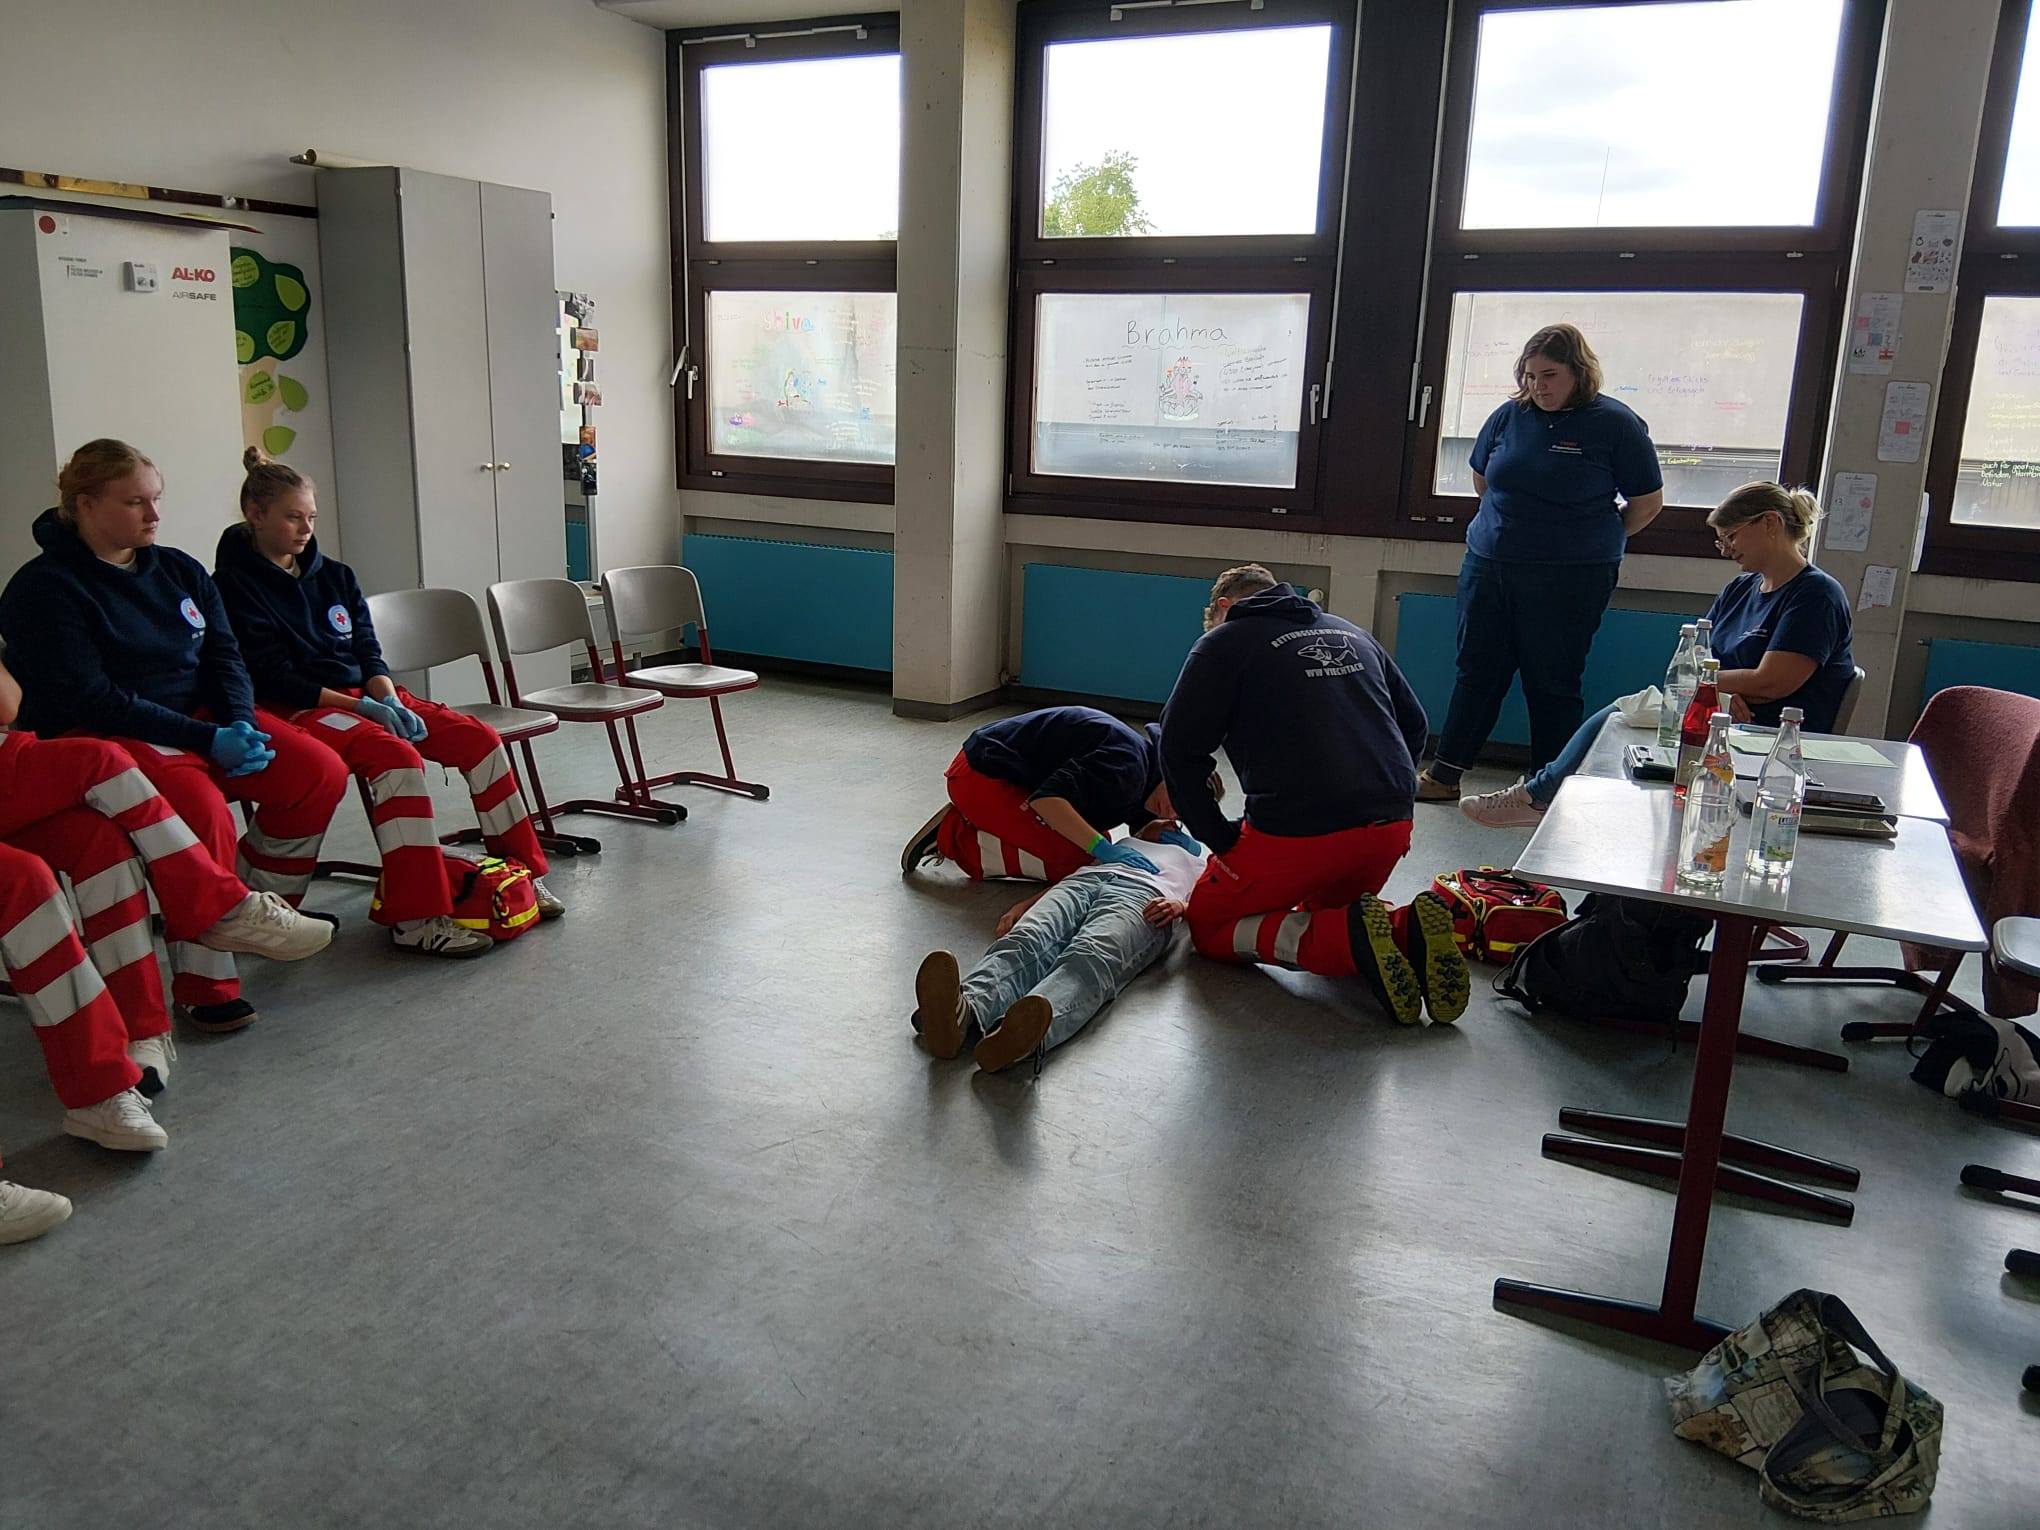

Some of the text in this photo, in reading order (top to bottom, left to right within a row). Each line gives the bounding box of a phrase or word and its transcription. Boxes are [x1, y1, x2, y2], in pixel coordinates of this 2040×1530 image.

[171, 267, 215, 283] AL-KO
[172, 291, 217, 301] AIRSAFE
[1126, 316, 1228, 345] Brahma
[1305, 668, 1323, 677] WW
